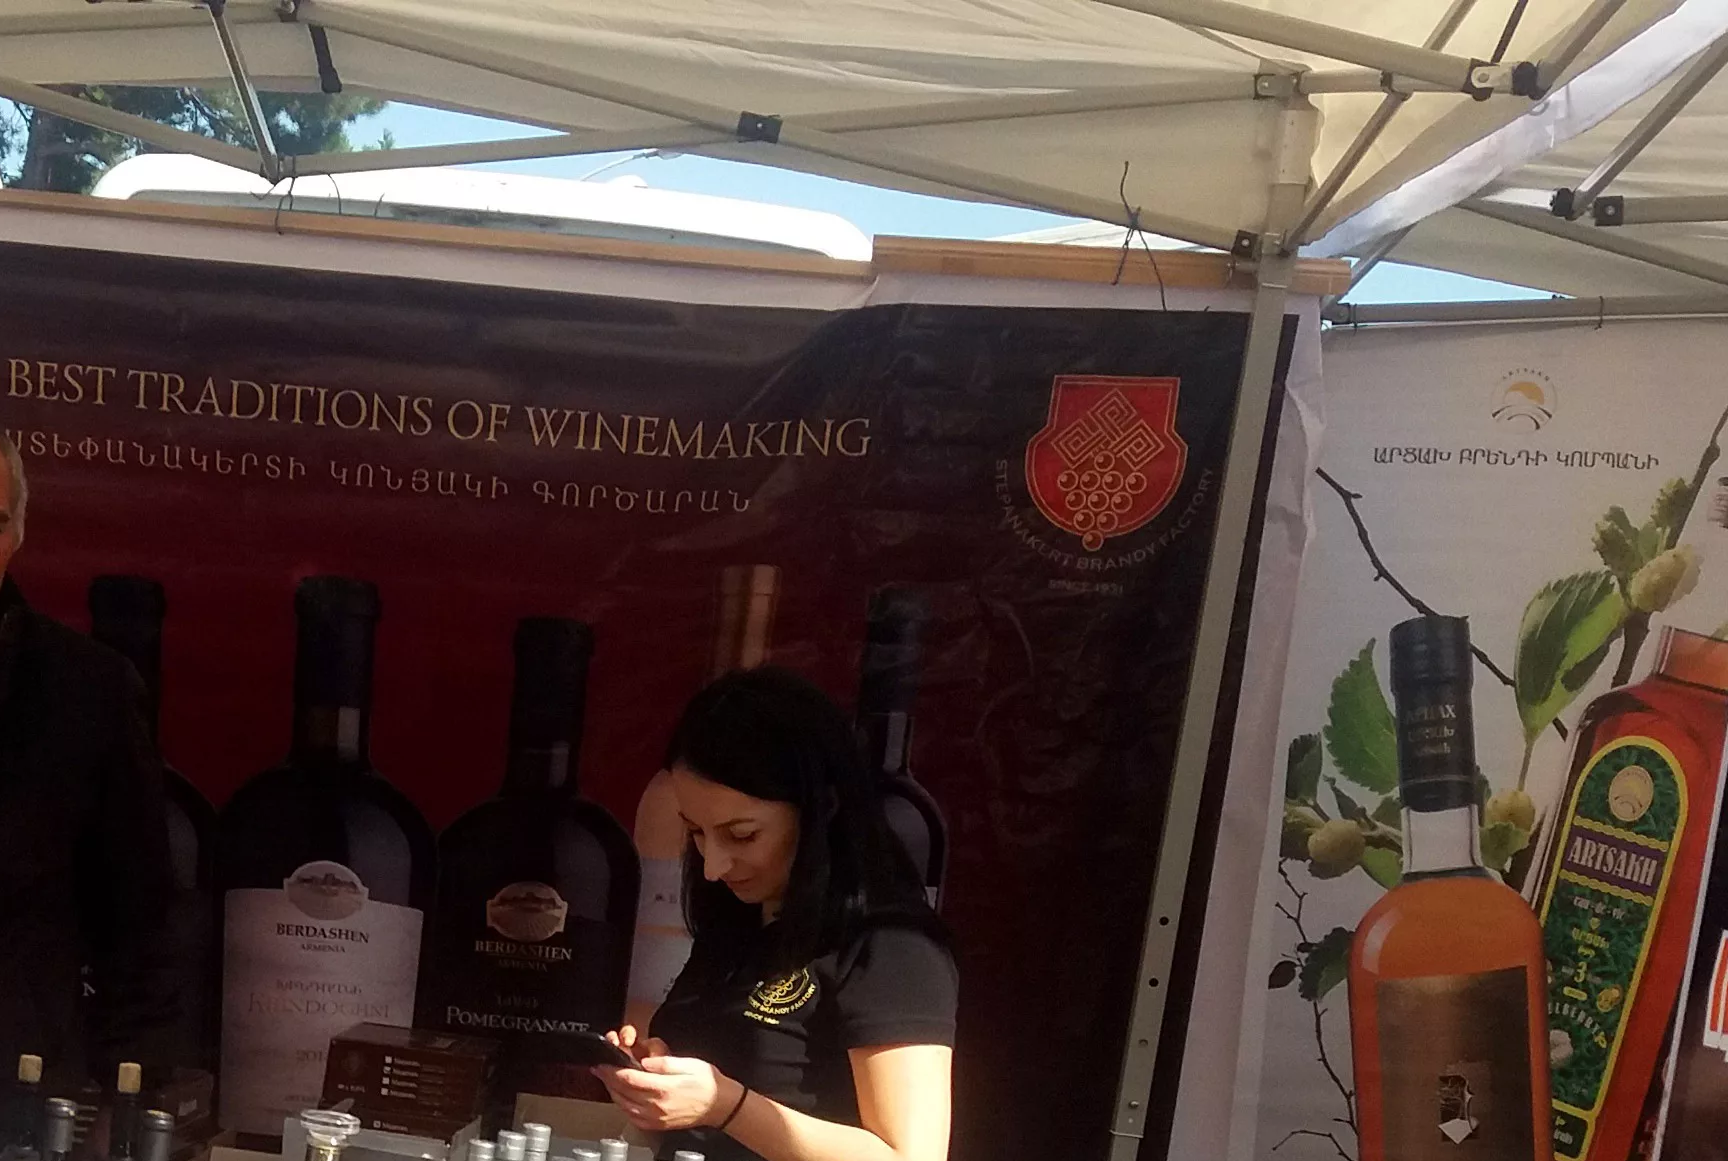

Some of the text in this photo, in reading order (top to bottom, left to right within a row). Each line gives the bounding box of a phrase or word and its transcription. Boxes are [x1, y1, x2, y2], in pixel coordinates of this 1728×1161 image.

[7, 357, 115, 406] BEST
[126, 368, 434, 437] TRADITIONS
[446, 399, 511, 444] OF
[523, 405, 872, 460] WINEMAKING
[328, 459, 509, 500] ԿՈՆՅԱԿԻ
[532, 478, 752, 514] ԳՈՐԾԱՐԱՆ
[995, 459, 1214, 571] STEPANAKERT BRANDY FACTORY
[1567, 836, 1658, 887] ARTSAKH
[276, 922, 370, 944] BERDASHEN
[474, 939, 573, 961] BERDASHEN
[446, 1005, 591, 1033] POMEGRANATE
